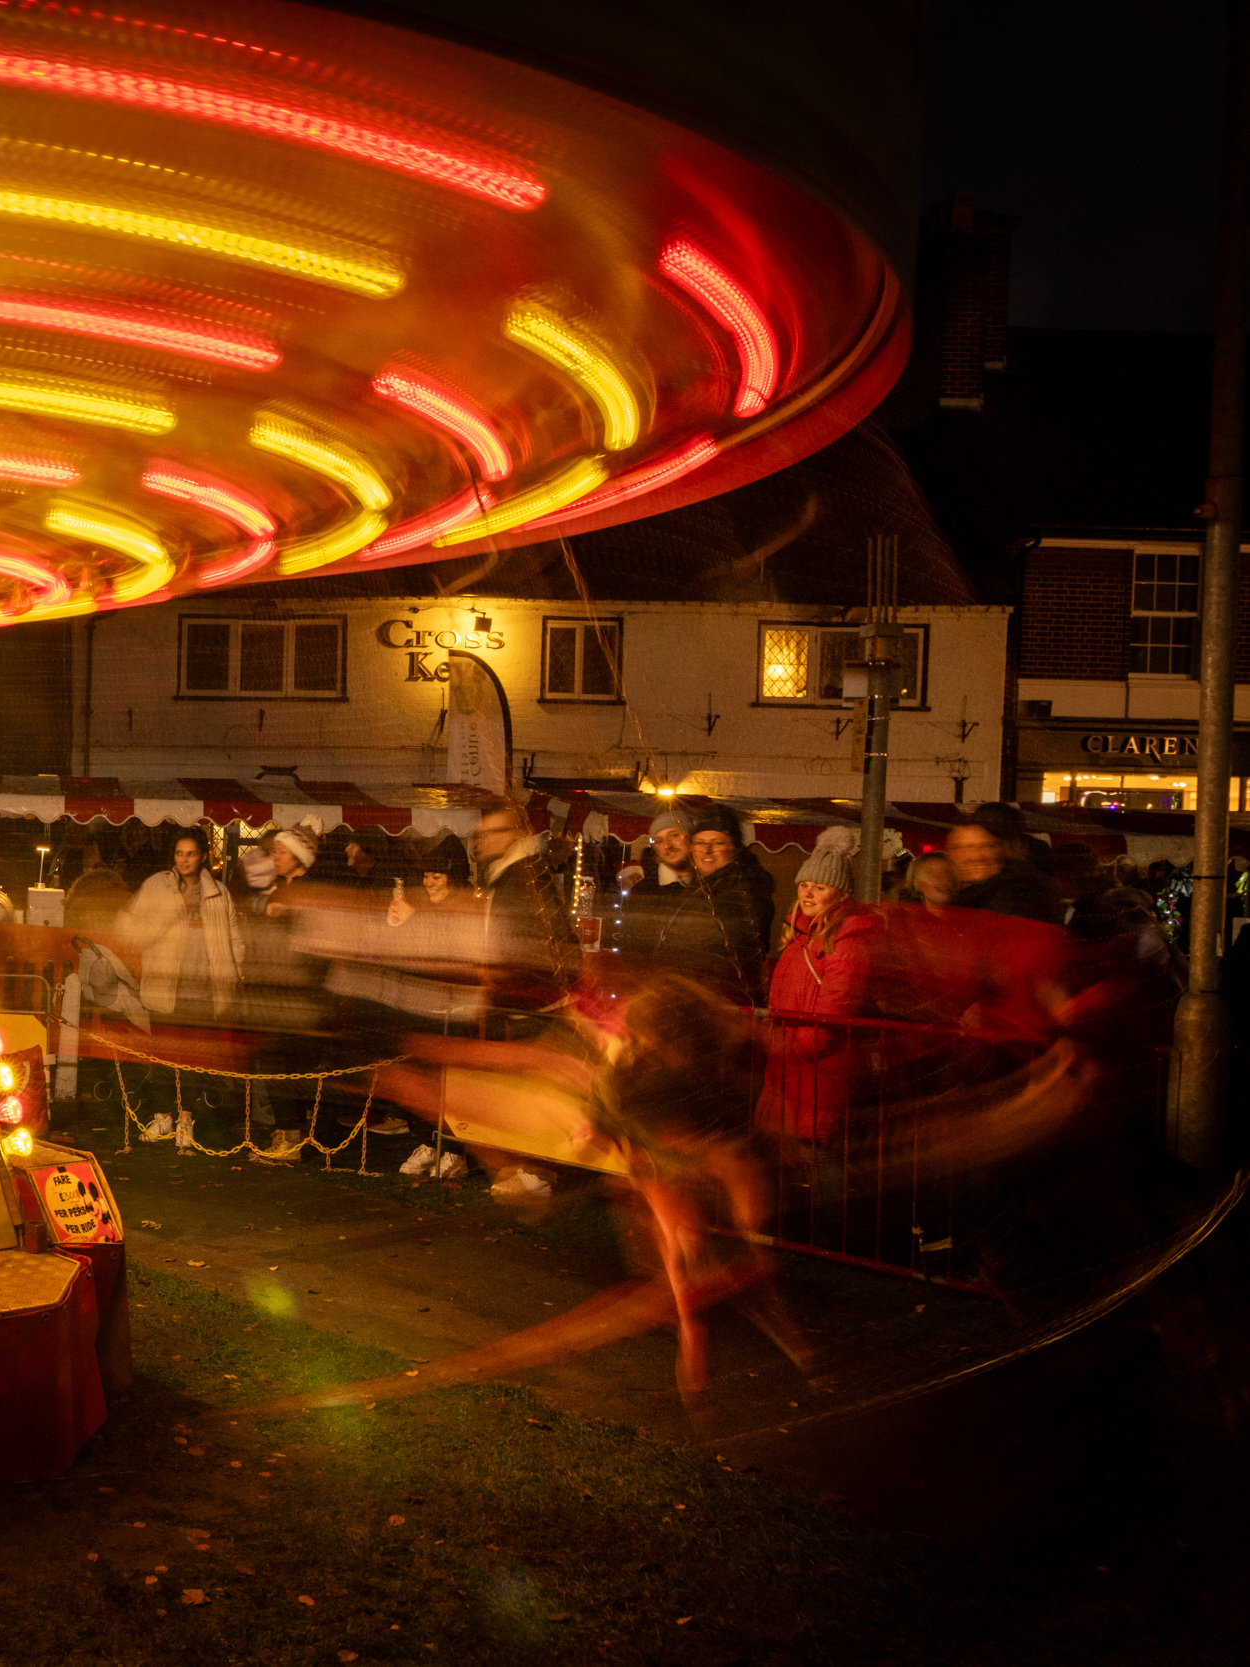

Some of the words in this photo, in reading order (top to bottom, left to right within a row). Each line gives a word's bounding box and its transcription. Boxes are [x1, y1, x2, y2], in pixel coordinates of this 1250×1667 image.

[376, 619, 505, 650] Cross
[53, 1175, 72, 1187] FARE
[54, 1209, 69, 1218] PER
[68, 1203, 94, 1218] PERSON
[65, 1224, 81, 1234] PER
[80, 1219, 97, 1233] RIDE
